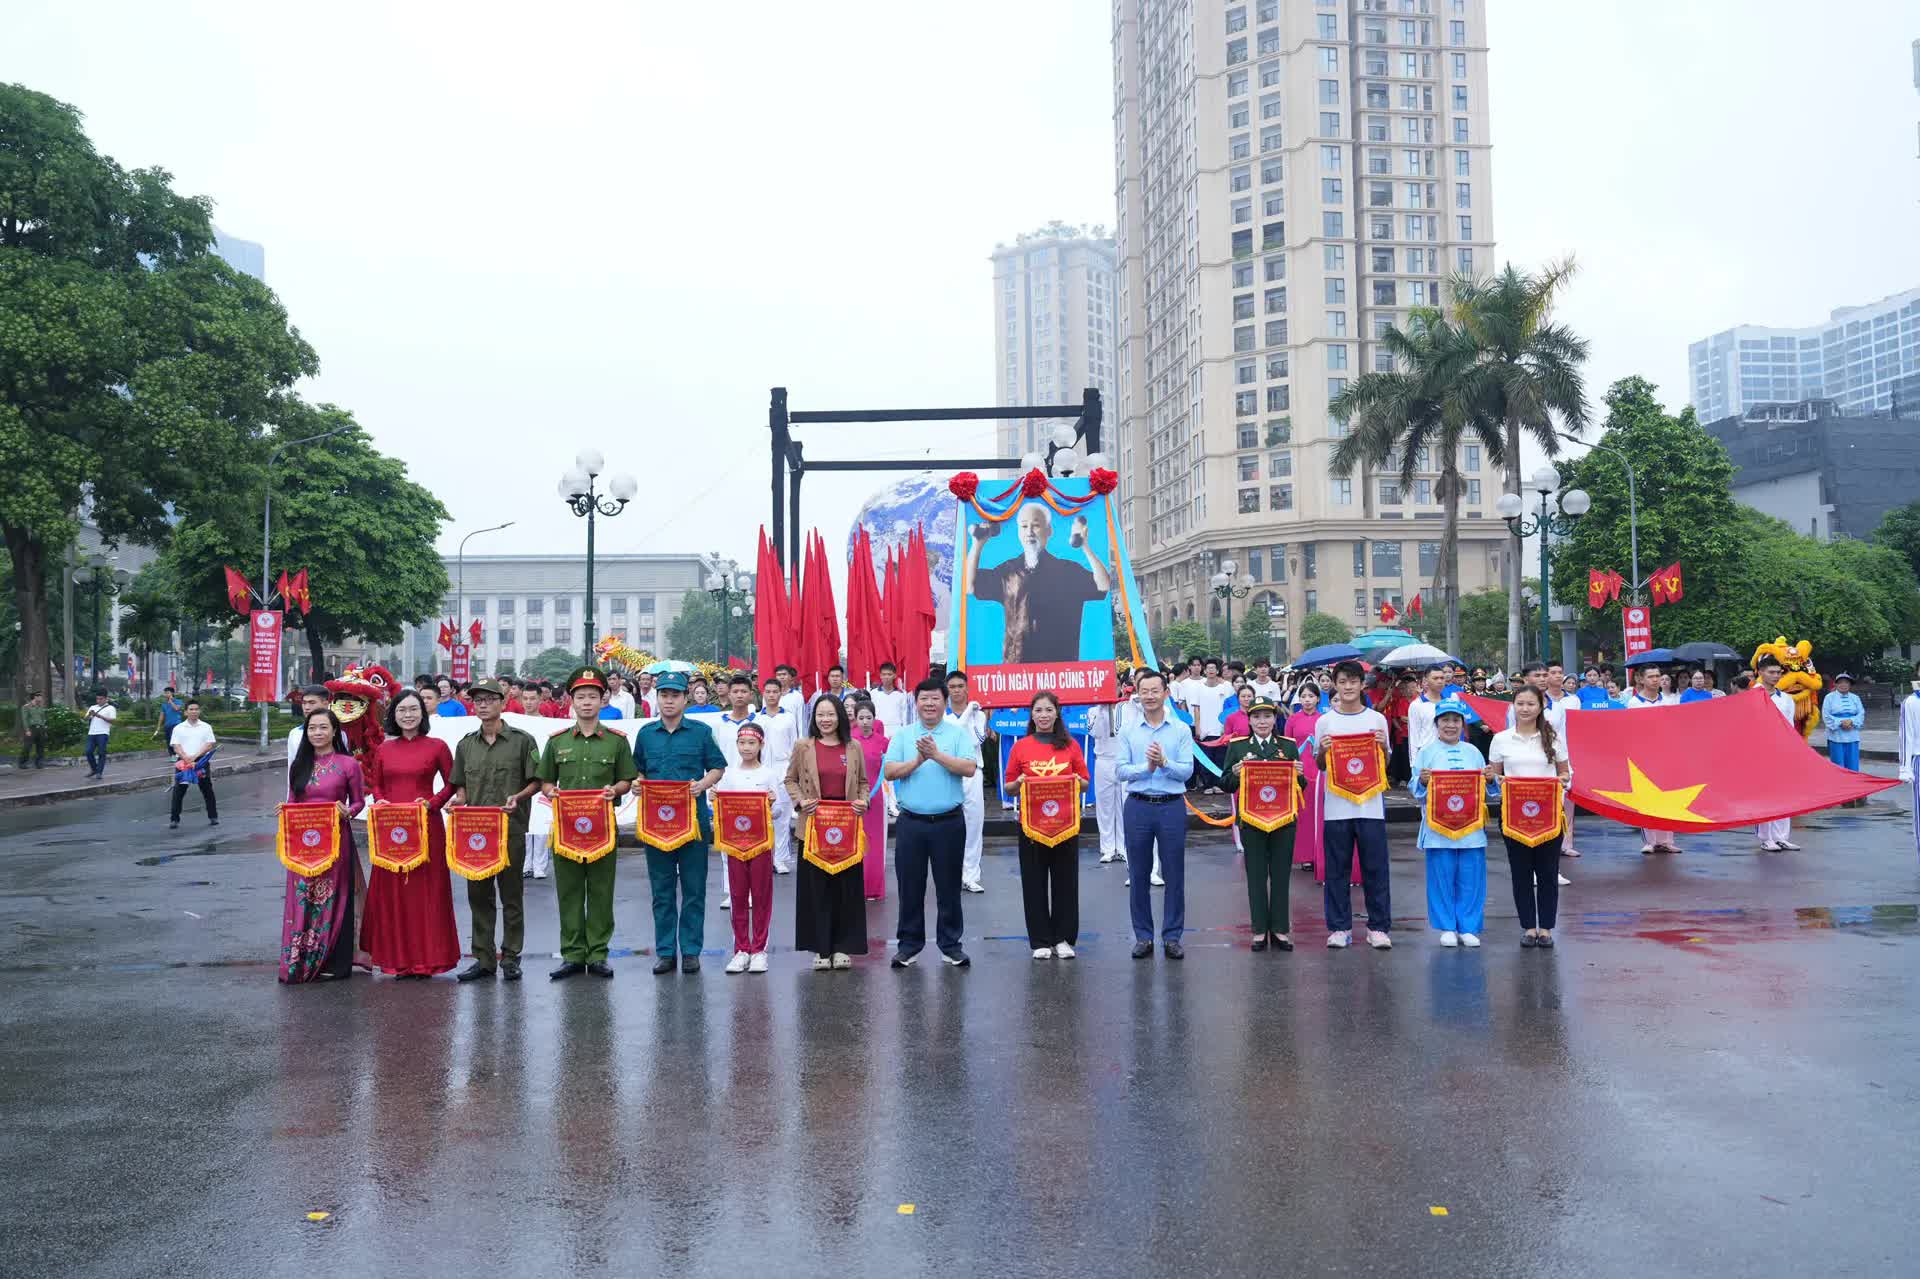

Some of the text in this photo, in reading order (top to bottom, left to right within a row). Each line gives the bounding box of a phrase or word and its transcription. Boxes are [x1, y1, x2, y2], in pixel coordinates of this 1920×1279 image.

[991, 673, 1006, 692] TÔI
[1009, 670, 1034, 690] NGÀY
[1037, 670, 1056, 690] NÀO
[1059, 669, 1085, 689] CŨNG
